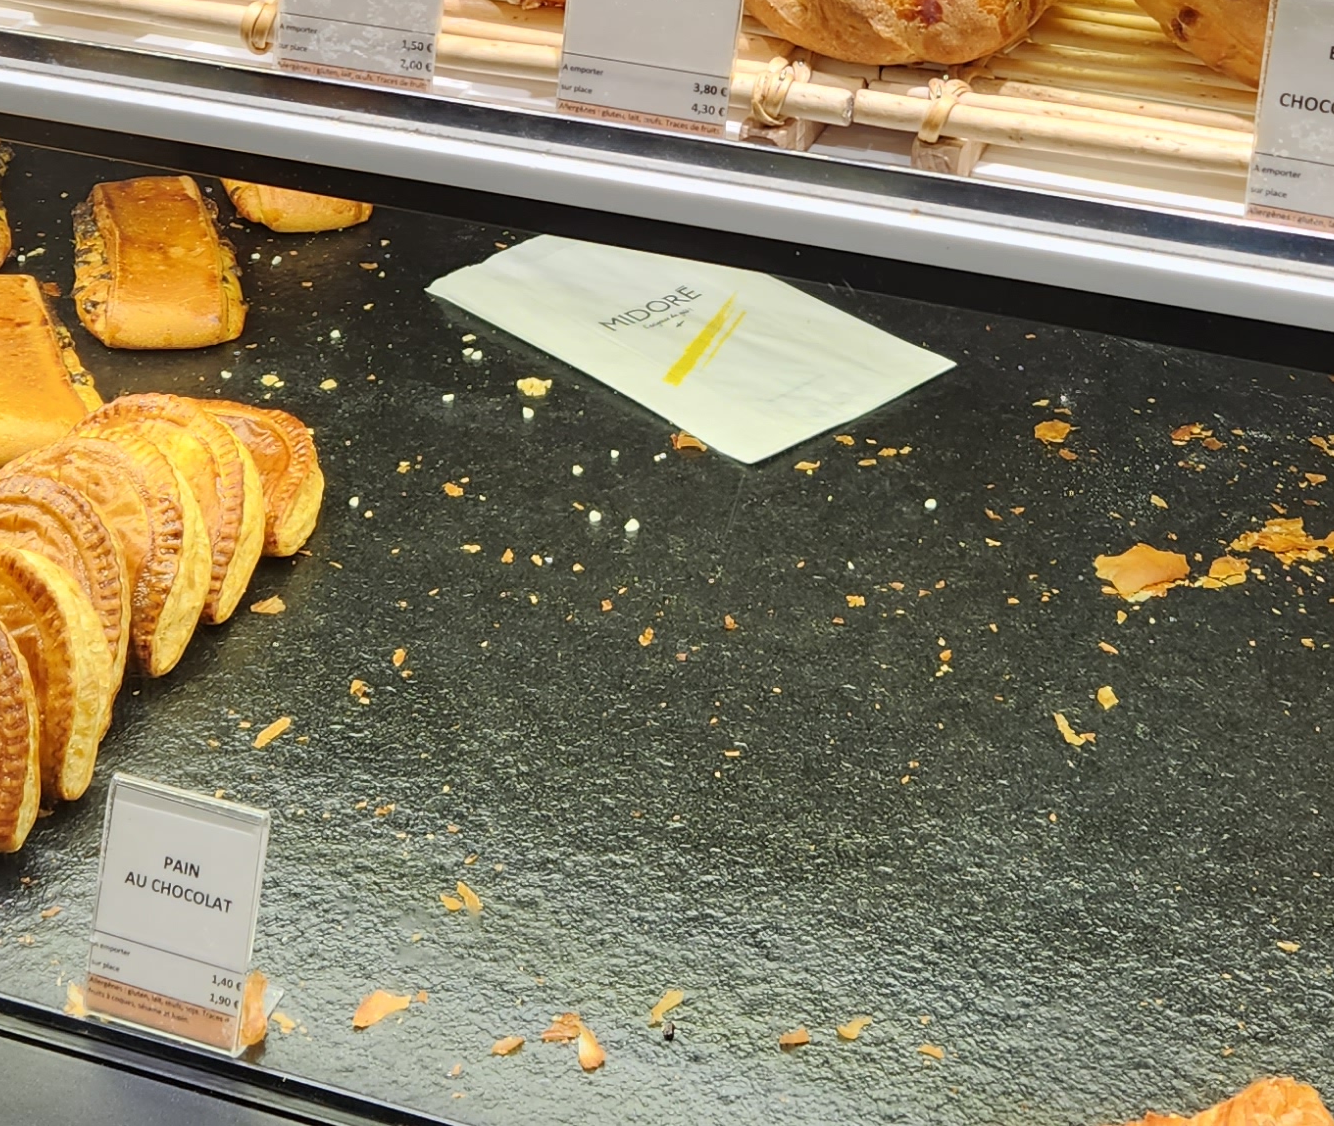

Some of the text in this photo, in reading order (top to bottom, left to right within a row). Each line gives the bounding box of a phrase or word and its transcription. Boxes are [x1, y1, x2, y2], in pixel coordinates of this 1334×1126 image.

[402, 39, 424, 52] 1,50
[427, 43, 433, 53] €
[400, 58, 422, 72] 2,00
[425, 63, 432, 73] €
[570, 65, 728, 97] emporter 3,80 €
[574, 84, 593, 95] place
[691, 103, 715, 116] 4,30
[718, 107, 725, 117] €
[1261, 166, 1301, 179] emporter
[1265, 187, 1287, 199] place
[163, 855, 200, 878] PAIN
[124, 871, 232, 914] AU CHOCOLAT
[212, 975, 234, 988] 1,40
[210, 993, 231, 1007] 1,90
